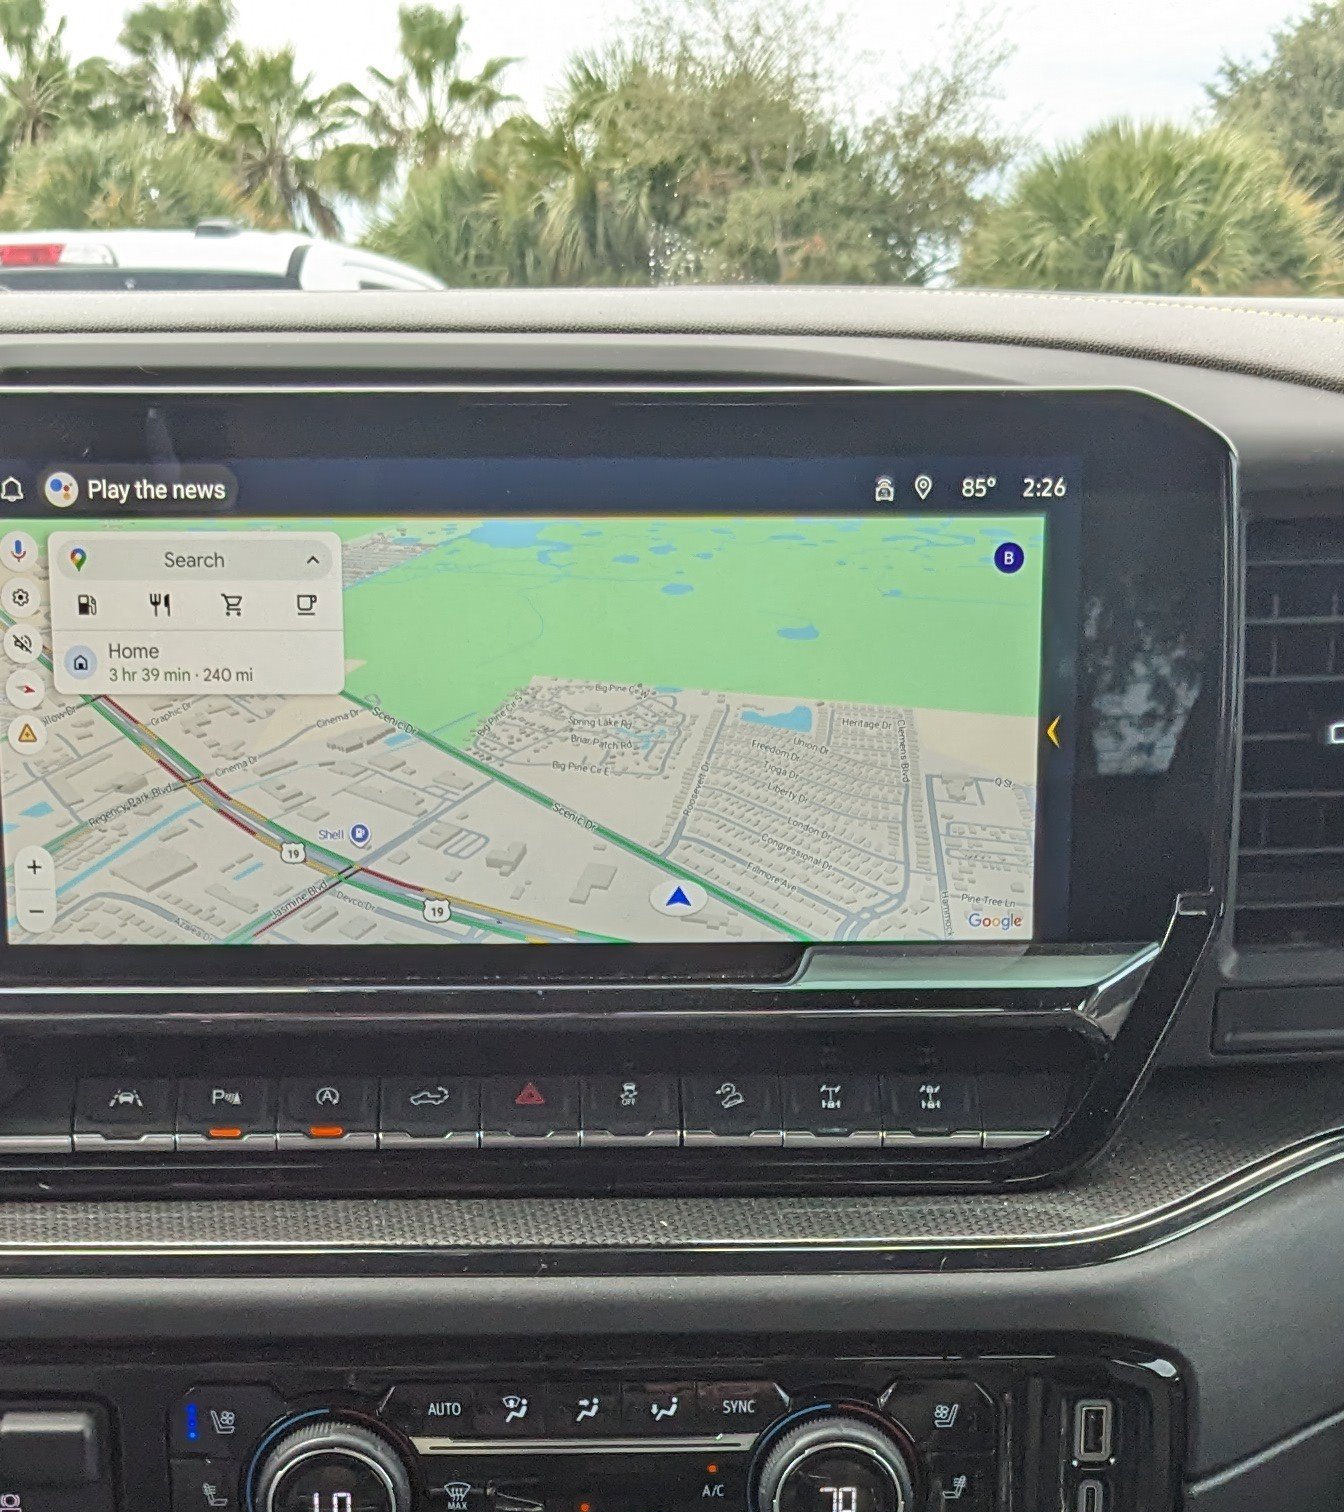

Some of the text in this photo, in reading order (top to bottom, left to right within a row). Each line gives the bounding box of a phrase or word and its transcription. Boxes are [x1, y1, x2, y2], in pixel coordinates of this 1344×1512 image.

[88, 479, 226, 504] Play the news
[1022, 476, 1067, 498] 2:26
[164, 551, 226, 569] Search
[1004, 551, 1014, 565] B
[109, 643, 160, 659] Home
[109, 667, 254, 682] 3 hr 39 min 240 mi
[150, 707, 183, 726] Graphic
[316, 708, 360, 728] Cinema Dr
[372, 706, 416, 735] Scenic Dr
[842, 718, 892, 730] Heritage Dr
[751, 739, 790, 760] Freedom
[897, 719, 911, 783] Clemens Blvd
[214, 760, 248, 777] Cinema
[768, 782, 798, 801] Liberty
[88, 802, 130, 828] Regency
[552, 802, 598, 831] Scenic Dr
[318, 829, 345, 841] Shell
[787, 816, 832, 840] London Dr
[288, 849, 300, 859] 19
[761, 833, 822, 866] Congressional
[780, 878, 798, 892] Ave
[271, 879, 329, 920] Jasmine Blvd
[961, 893, 1016, 908] Pine Tree Ln
[431, 907, 444, 918] 19
[968, 912, 1023, 931] Google
[428, 1402, 461, 1416] AUTO
[722, 1400, 756, 1414] SYNC
[701, 1484, 726, 1498] A/C
[447, 1501, 468, 1510] MAX
